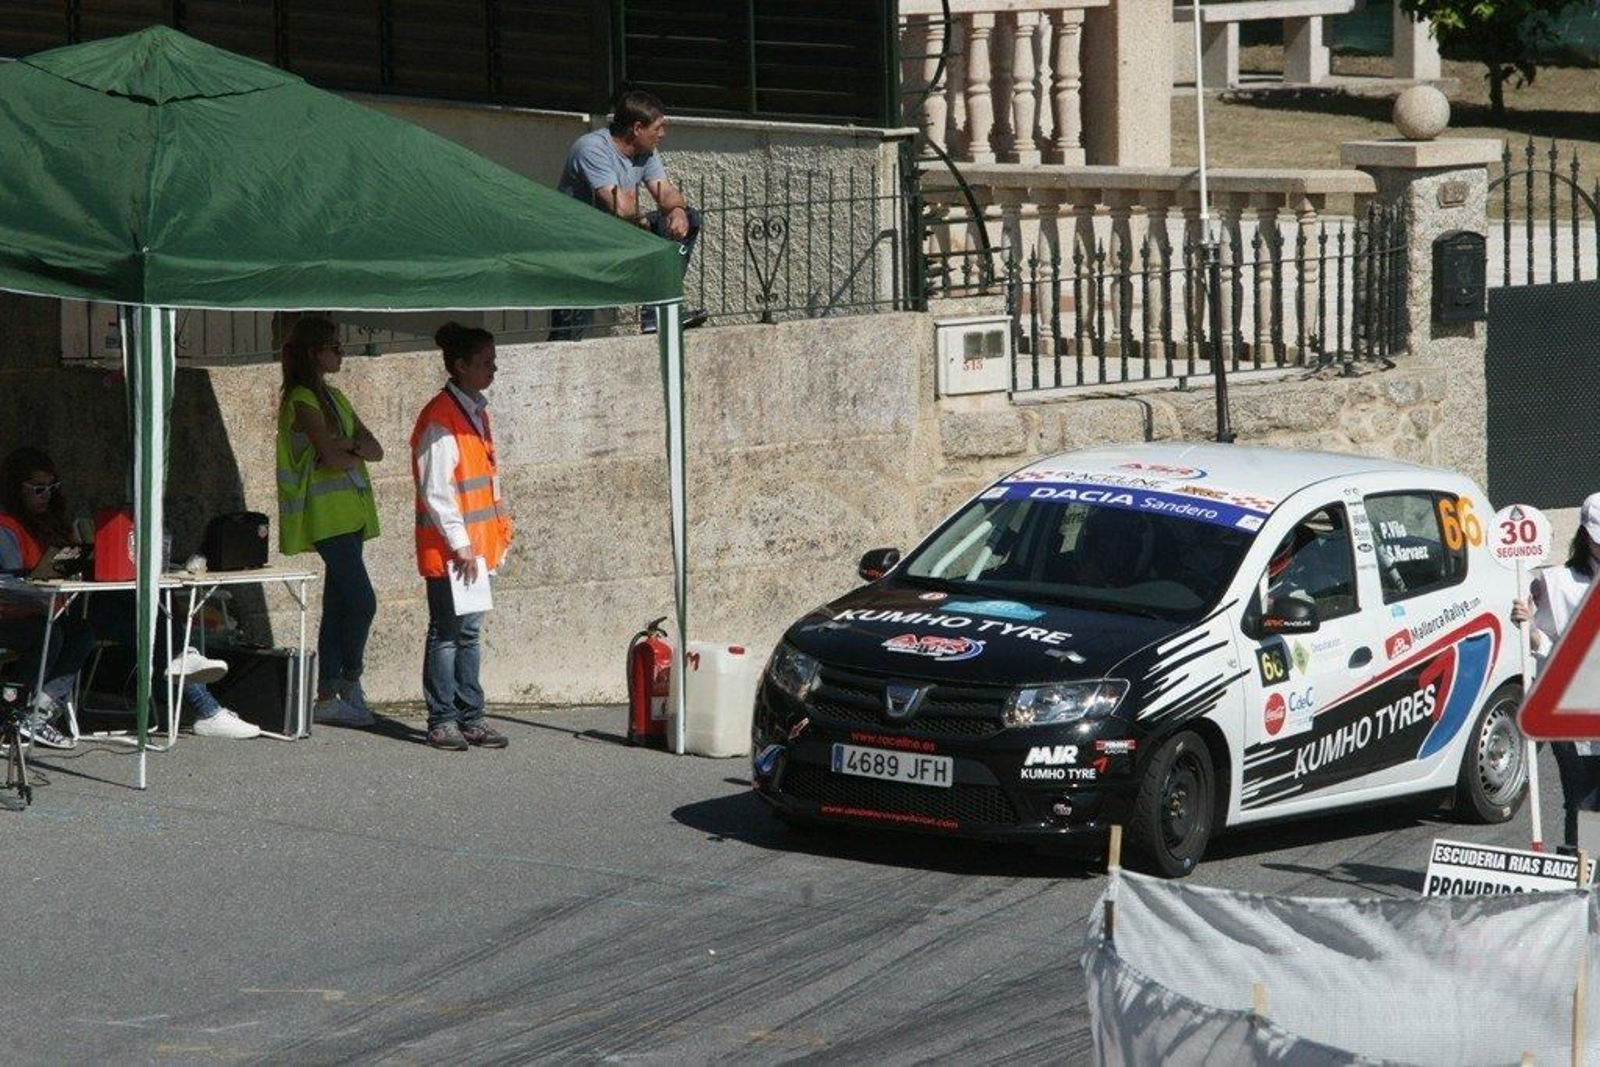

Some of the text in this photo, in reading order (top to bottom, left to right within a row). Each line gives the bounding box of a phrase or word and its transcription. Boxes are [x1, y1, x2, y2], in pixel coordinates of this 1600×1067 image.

[1029, 487, 1135, 506] DACIA
[1140, 498, 1218, 519] Sandero
[1439, 496, 1482, 550] 66
[1500, 519, 1537, 545] 30
[1496, 545, 1543, 558] SEGUNDOS
[832, 608, 972, 628] KUMHO
[977, 618, 1074, 645] TYRE
[1293, 683, 1437, 779] KUMHO TYRES
[847, 750, 947, 783] 4689 JFH
[1021, 768, 1096, 780] KUMHO TYRE
[1434, 845, 1590, 881] ESCUDERIA RIAS BAIX
